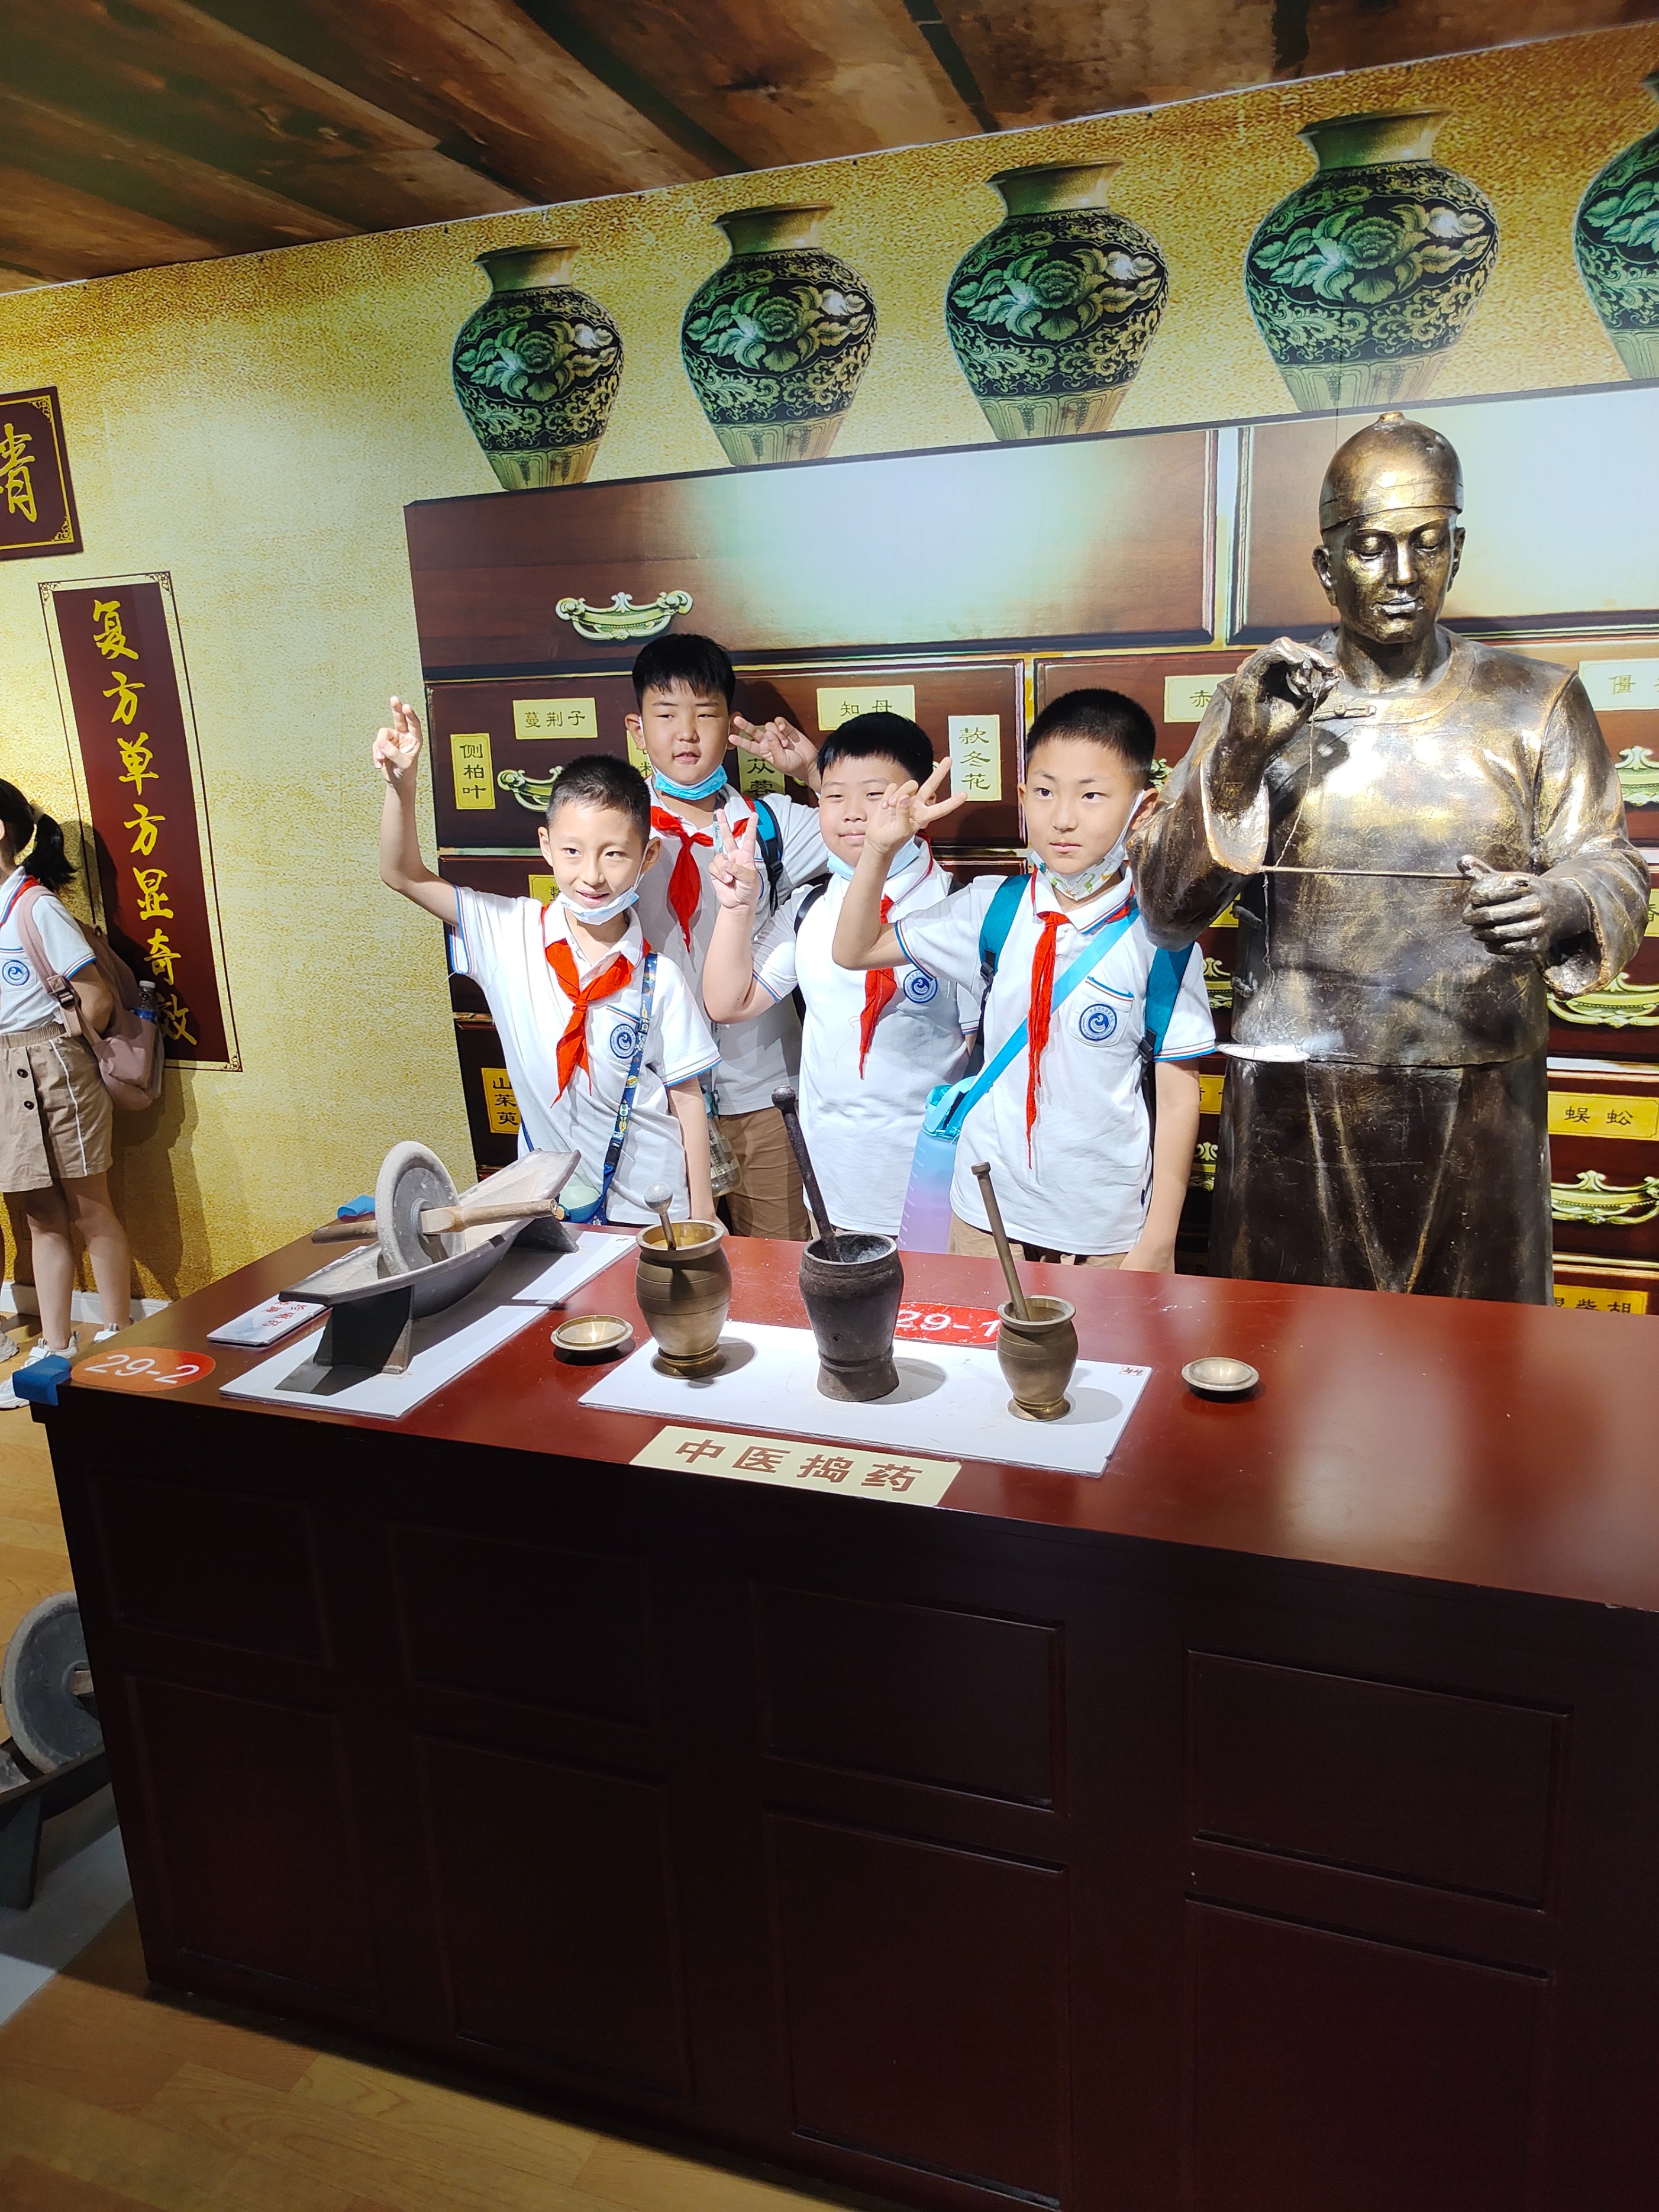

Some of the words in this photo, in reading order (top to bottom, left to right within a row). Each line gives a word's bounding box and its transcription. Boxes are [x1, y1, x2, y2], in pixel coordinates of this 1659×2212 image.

[524, 710, 586, 728] 蔓荆子
[840, 699, 893, 717] 知母
[459, 743, 487, 800] 侧柏叶
[747, 739, 777, 797] 苁蓉
[958, 726, 990, 791] 款冬花
[492, 1076, 519, 1126] 山茱萸
[1564, 1105, 1634, 1127] 蜈蚣
[895, 1310, 1001, 1338] 29-1
[85, 1354, 200, 1385] 29-2
[674, 1437, 924, 1493] 中医捣药
